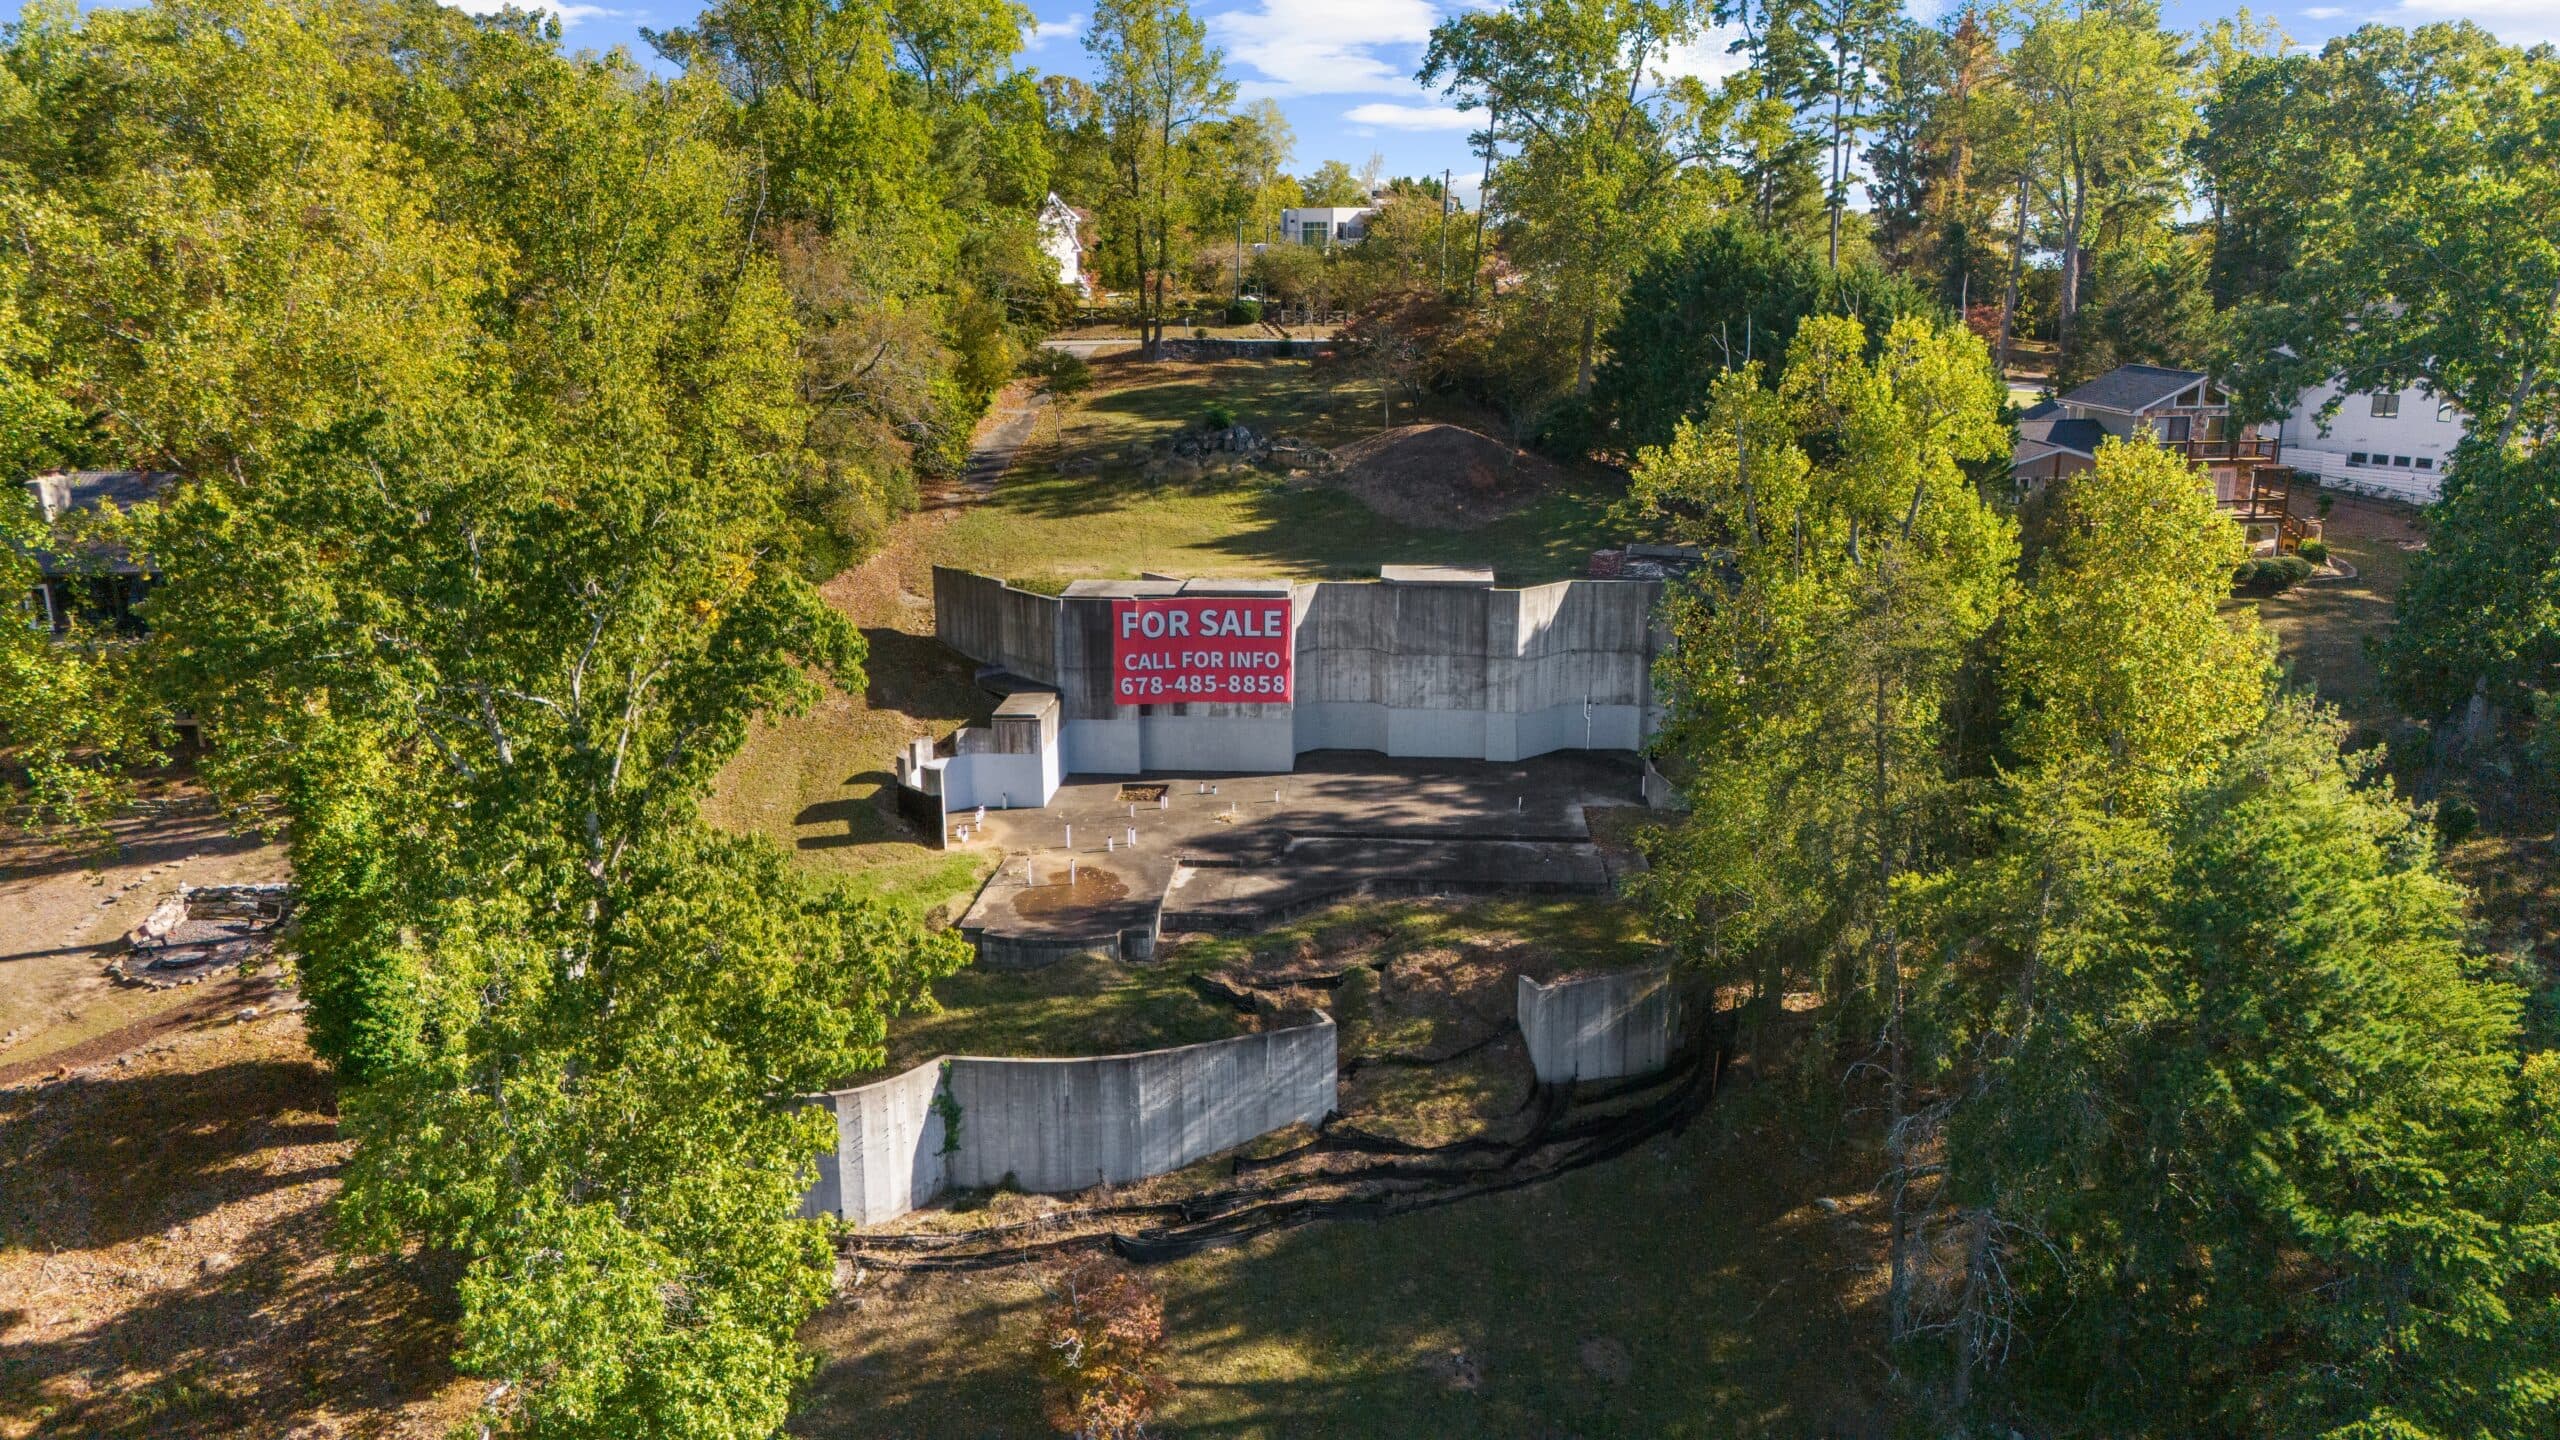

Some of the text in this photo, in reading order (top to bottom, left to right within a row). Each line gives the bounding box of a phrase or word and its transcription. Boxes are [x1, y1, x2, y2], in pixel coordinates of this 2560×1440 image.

[1121, 609, 1282, 639] FOR SALE
[1124, 652, 1280, 670] CALL FOR INFO
[1120, 675, 1285, 695] 678-485-8858
